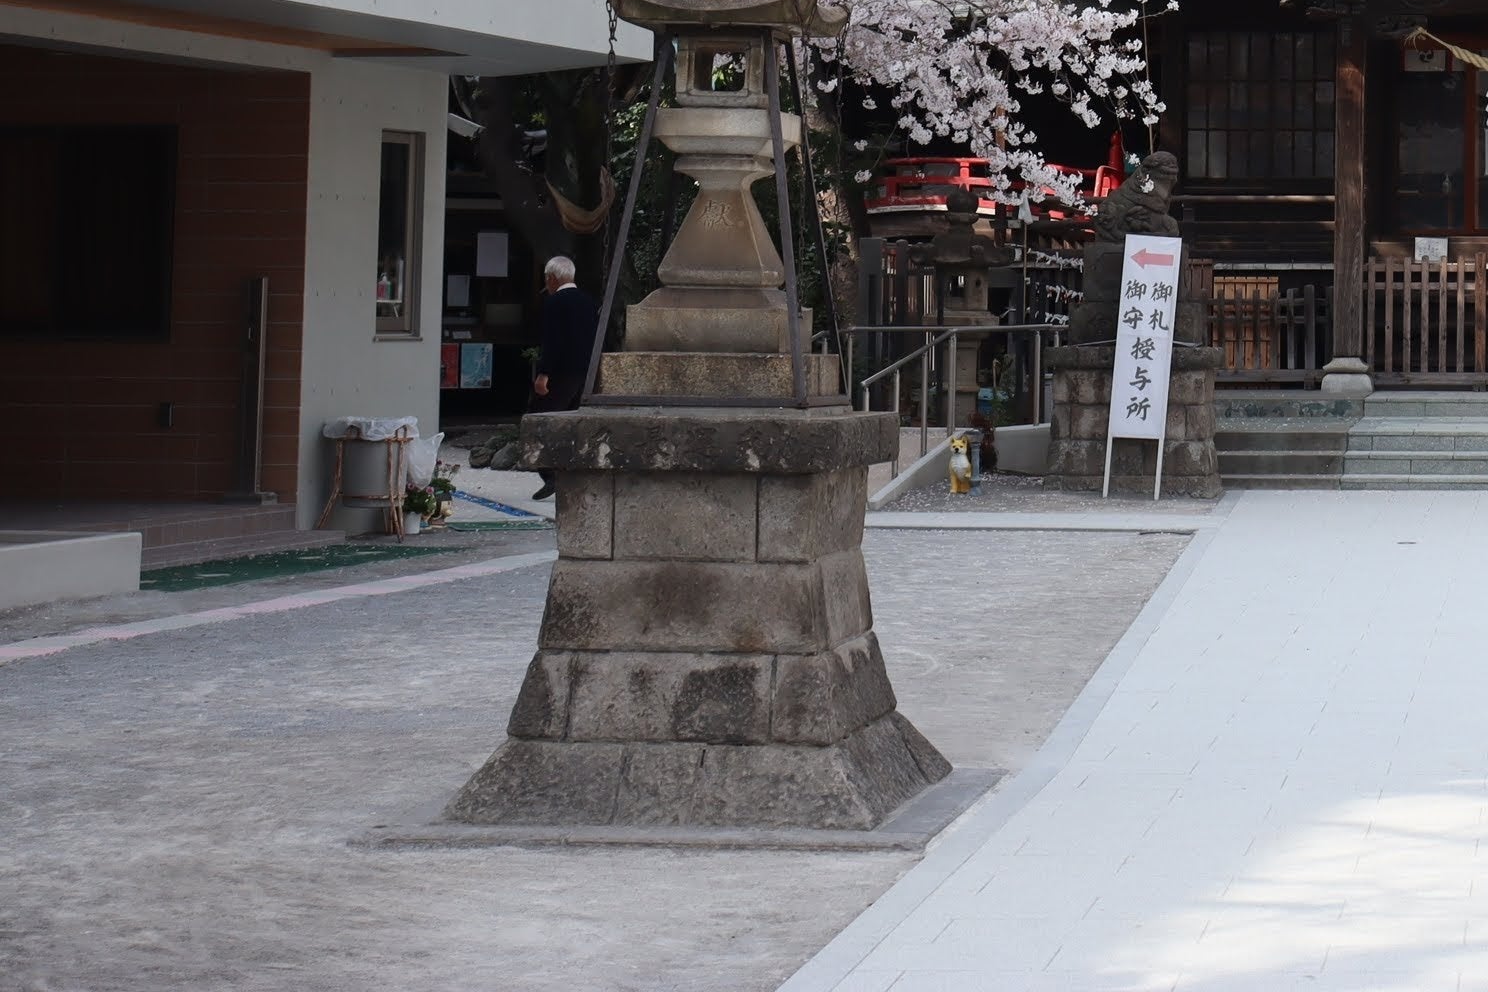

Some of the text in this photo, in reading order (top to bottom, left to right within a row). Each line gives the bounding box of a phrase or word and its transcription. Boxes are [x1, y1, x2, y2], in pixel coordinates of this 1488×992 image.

[1122, 280, 1147, 330] 御守
[1149, 282, 1173, 330] 御札
[1126, 338, 1156, 421] 授与所
